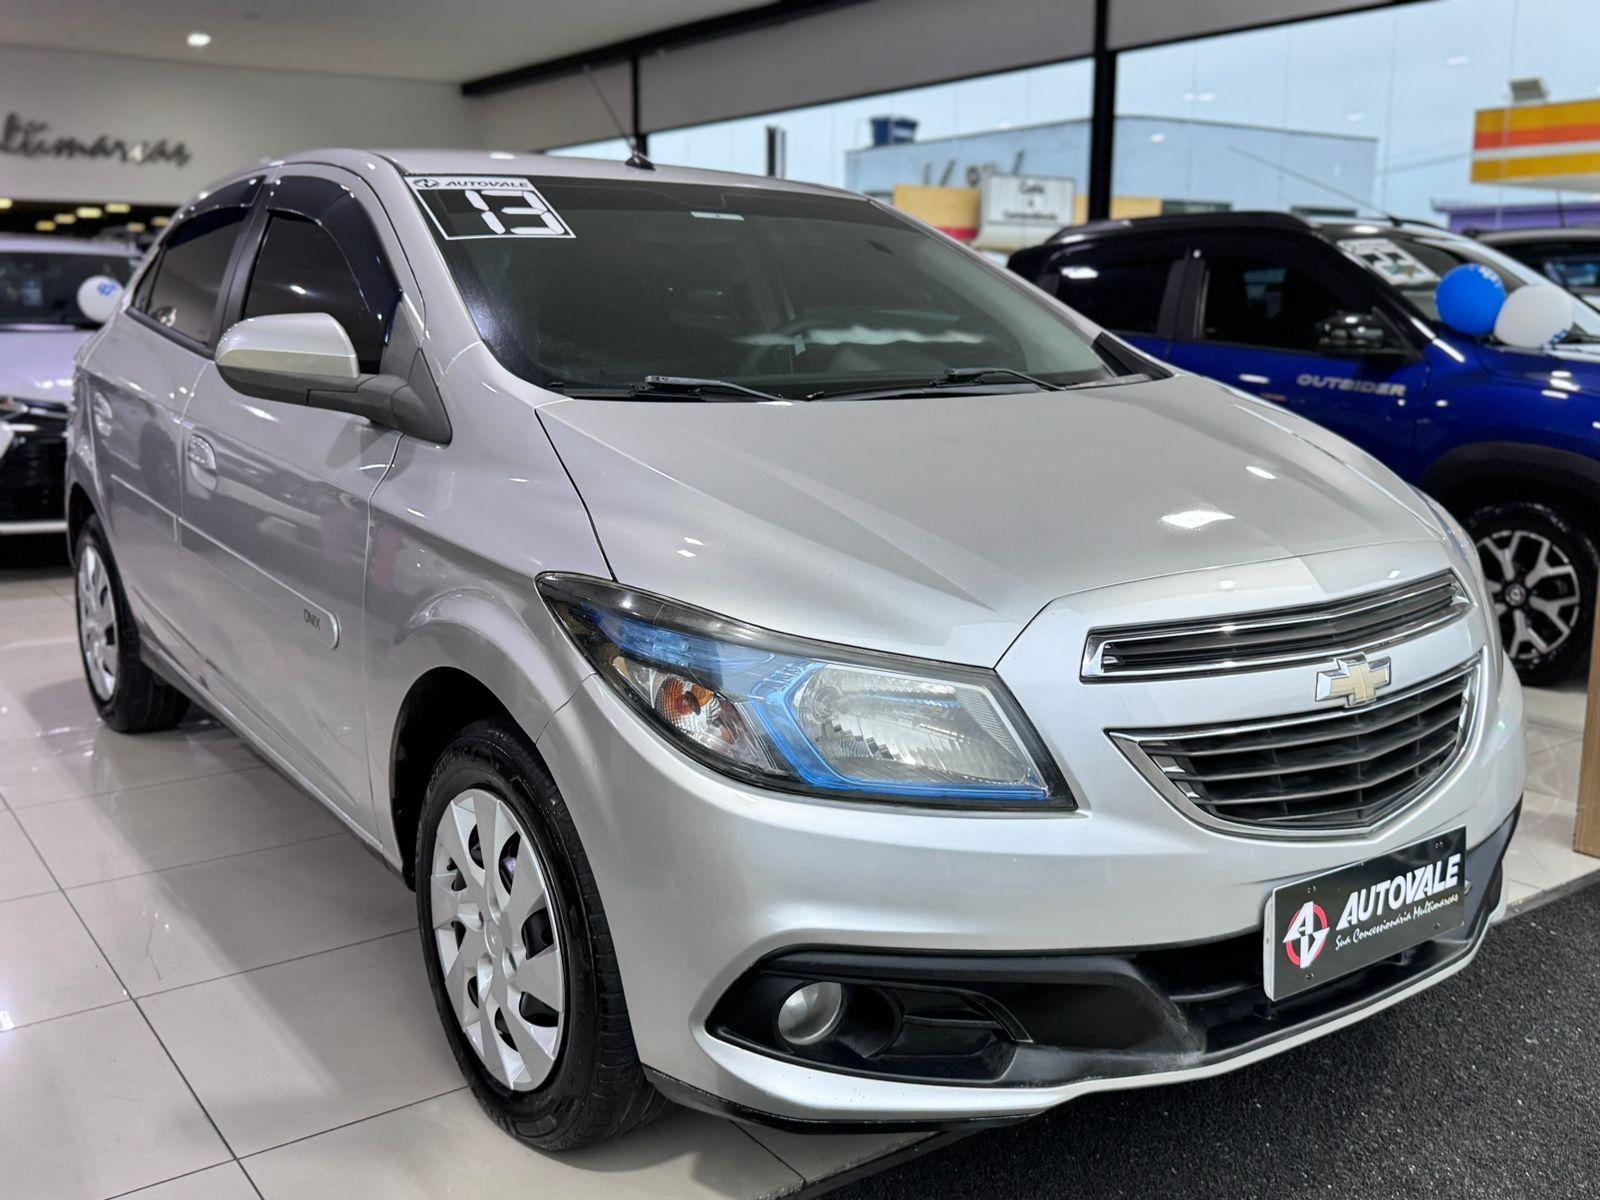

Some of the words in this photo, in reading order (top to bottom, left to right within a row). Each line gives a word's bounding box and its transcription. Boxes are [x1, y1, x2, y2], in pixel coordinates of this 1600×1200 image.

[445, 180, 529, 188] AUTOVALE
[465, 189, 566, 235] 13
[1296, 373, 1407, 397] OUTSIDER
[303, 608, 321, 631] ONIX
[1335, 853, 1461, 931] AUTOVALE
[1335, 934, 1351, 951] Sua
[1412, 893, 1459, 920] Multimarcas
